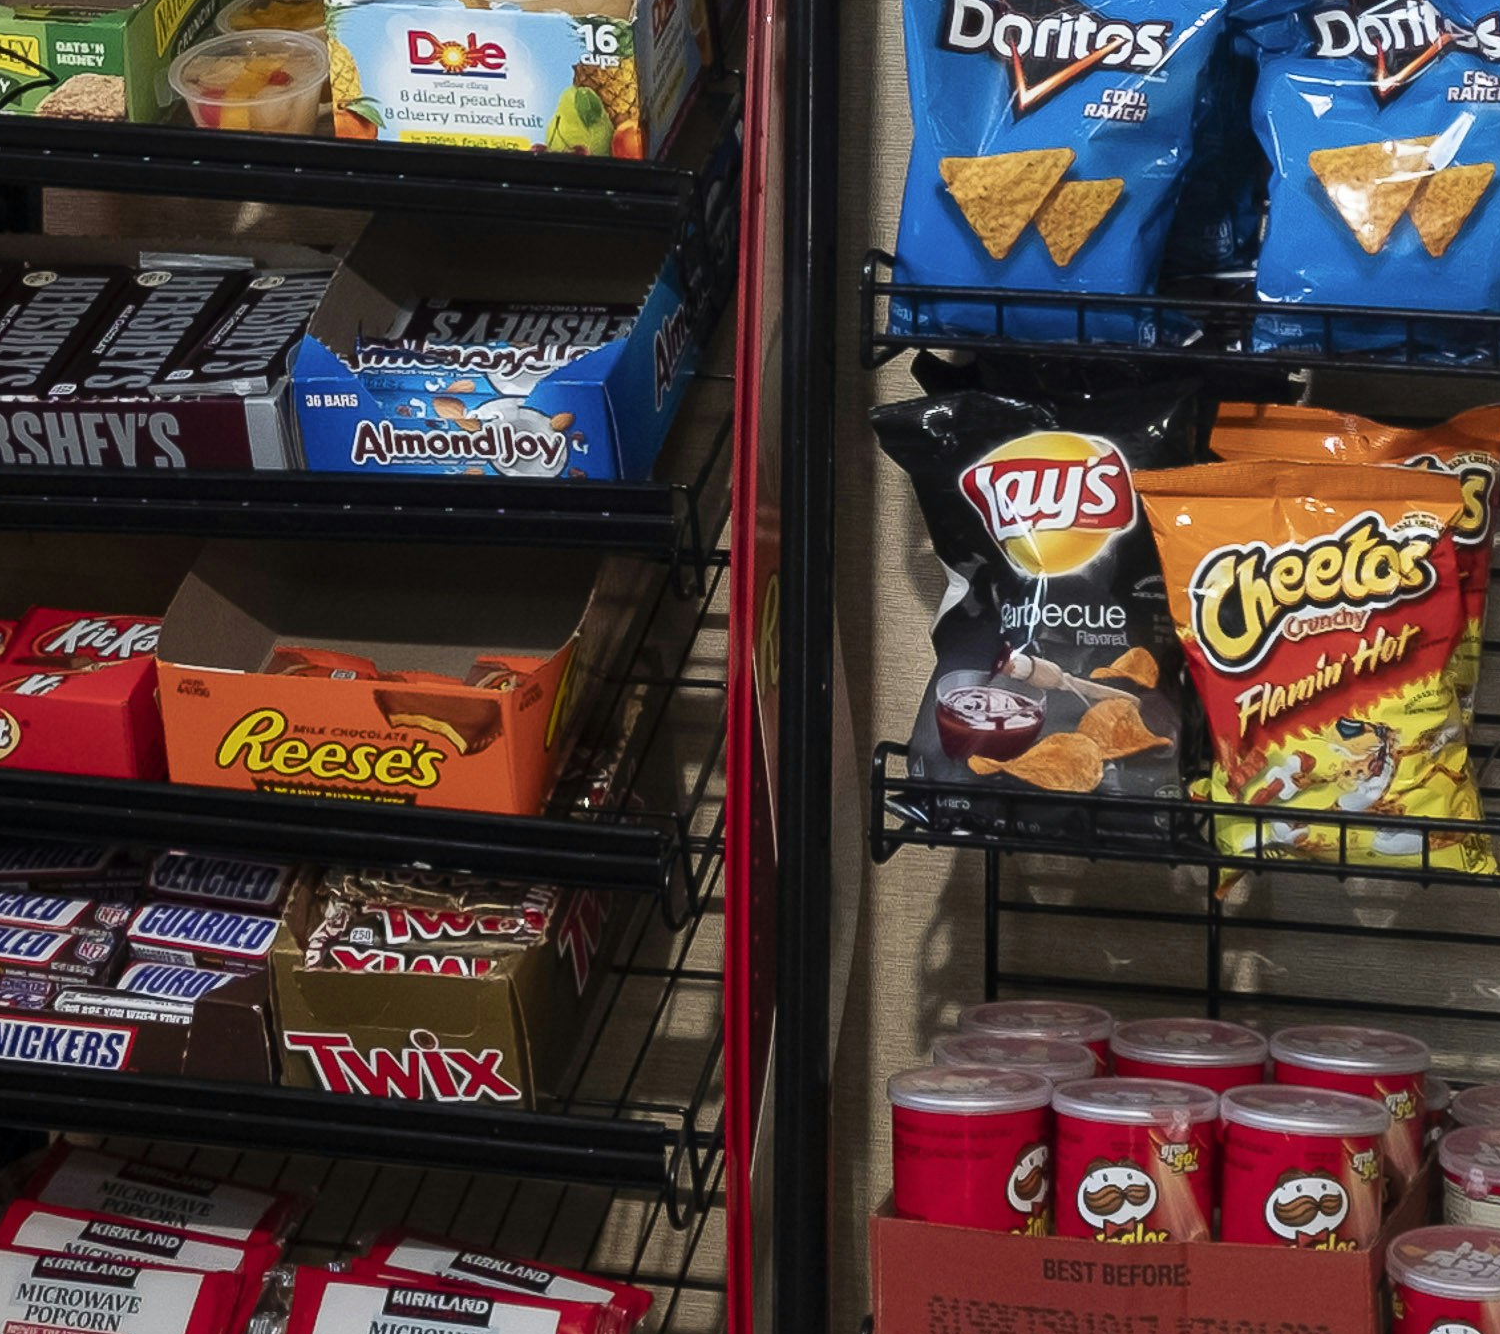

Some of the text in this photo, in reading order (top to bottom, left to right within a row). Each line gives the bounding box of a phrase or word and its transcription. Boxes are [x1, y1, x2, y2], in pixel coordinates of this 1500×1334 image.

[407, 29, 507, 75] Dole
[580, 24, 618, 53] 16
[56, 54, 105, 67] HONEY
[579, 52, 620, 70] cups
[400, 90, 525, 109] 8 diced peaches
[1101, 89, 1148, 106] COOL
[384, 106, 544, 129] 8 cherry mixed fruit
[1082, 103, 1149, 122] RANCH
[84, 275, 225, 390] HERSHEY'S
[324, 394, 358, 408] BARS
[352, 421, 565, 467] Almond Joy
[973, 460, 1121, 533] Lay's
[1199, 533, 1435, 663] Cheetos
[1283, 607, 1370, 641] Crunchy
[1075, 630, 1128, 647] Flavored
[1234, 623, 1421, 731] Flamin' Hot
[292, 724, 408, 743] MILK CHOCOLATE
[217, 708, 445, 788] Reese's
[137, 906, 277, 950] GUARDED
[79, 941, 111, 961] NFL
[284, 1028, 521, 1101] Twix
[99, 1179, 215, 1218] MICROWAVE
[89, 1222, 180, 1250] KIRKLAND
[42, 1257, 135, 1277] KIRKLAND
[462, 1252, 551, 1284] KIRKLAND
[1043, 1259, 1190, 1287] BEST BEFORE:
[15, 1283, 142, 1314] MICROWAVE
[393, 1290, 489, 1315] KIRKLAND
[24, 1304, 122, 1332] POPCORN
